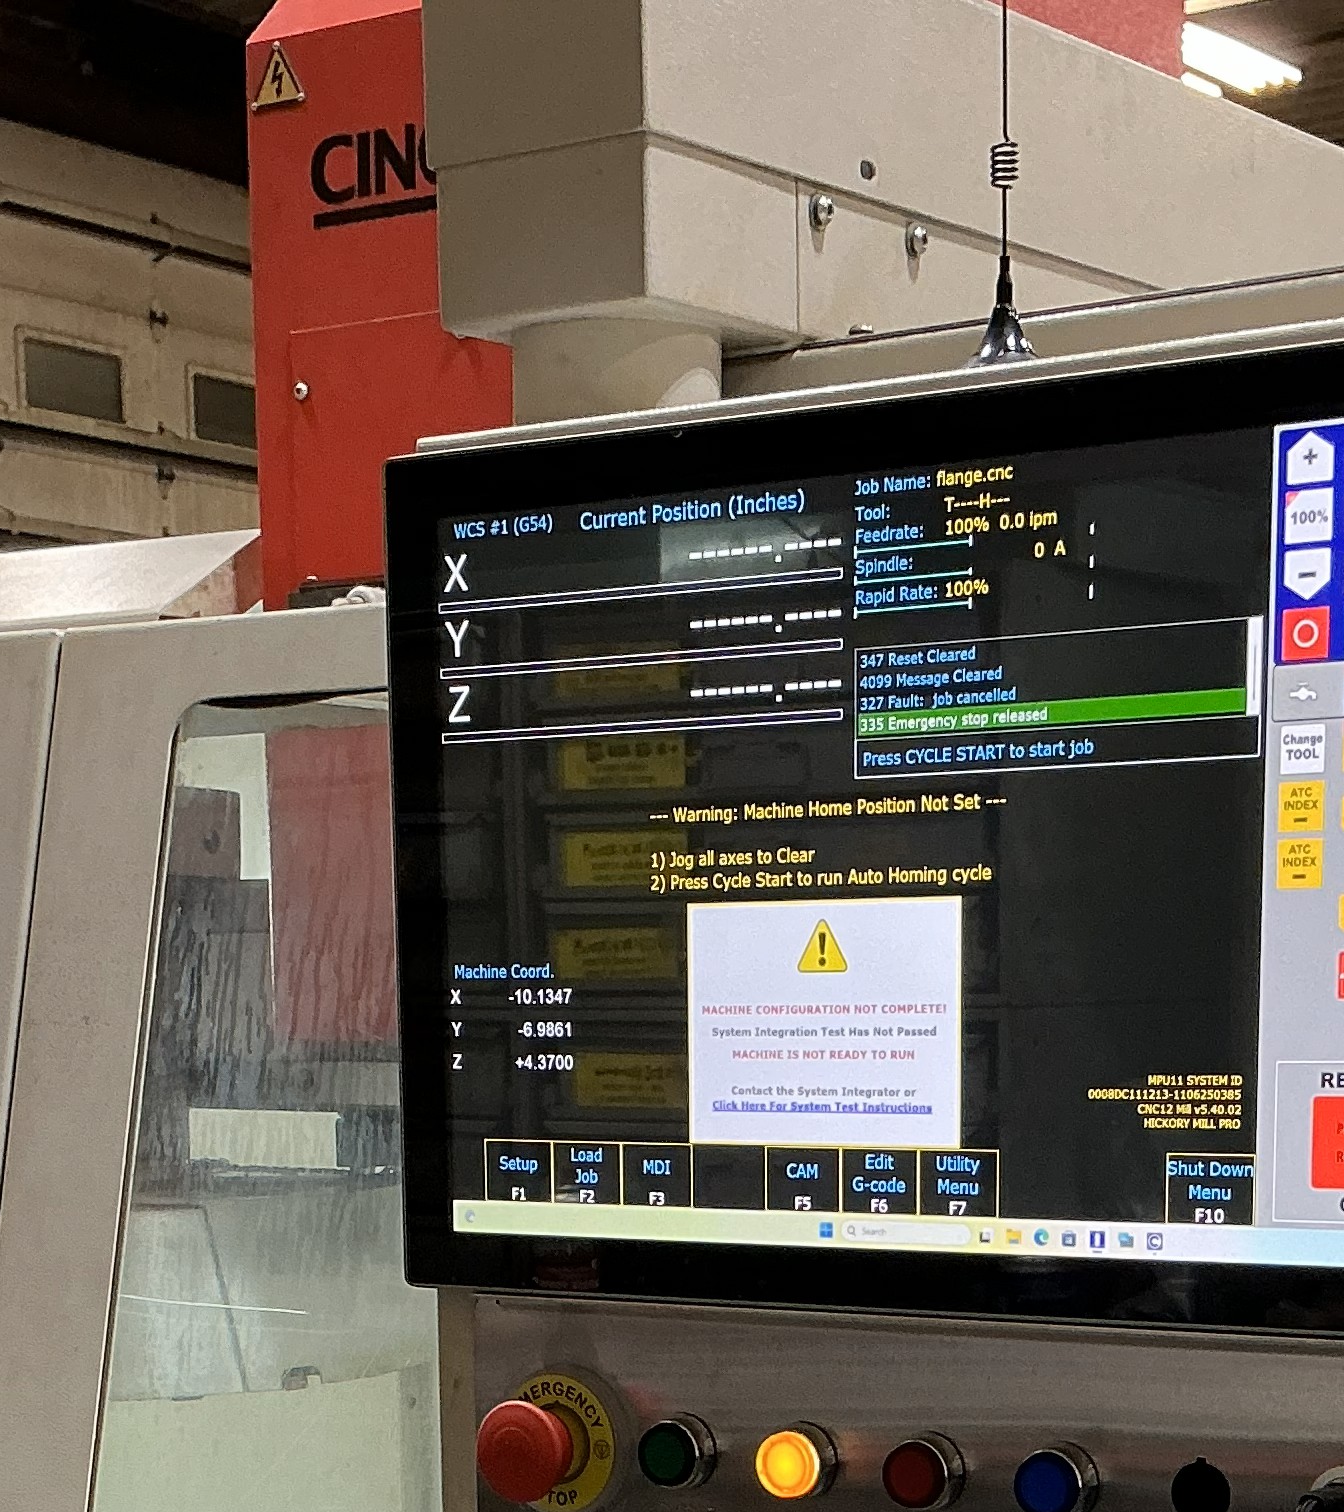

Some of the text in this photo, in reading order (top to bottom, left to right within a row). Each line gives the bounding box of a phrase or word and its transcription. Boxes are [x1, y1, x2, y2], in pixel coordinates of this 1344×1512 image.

[855, 466, 1013, 495] Job Name: flange.cnc
[580, 488, 804, 530] Current Position (Inches)
[1291, 510, 1328, 525] 100%
[454, 514, 552, 539] WCS #1 (G54)
[856, 510, 1057, 544] Feedrate: 100% 0.0 ipm
[444, 554, 468, 592] X
[856, 579, 989, 607] Rapid Rate: 100%
[445, 619, 469, 657] Y
[860, 645, 975, 668] 347 Reset Cleared
[449, 685, 470, 723] Z
[861, 707, 1047, 733] 335 Emergency stop released
[1283, 734, 1323, 746] Change
[864, 738, 1094, 766] Press CYCLE START to start job
[1286, 748, 1319, 760] TOOL
[673, 794, 981, 824] Warning: Machine Home Position Not Set
[651, 847, 815, 870] 1) Jog all axes to Clear
[651, 864, 992, 892] 2) Press Cycle Start to run Auto Homing cycle
[455, 963, 554, 979] Machine Coord.
[450, 988, 572, 1004] X -10.1347
[702, 1004, 946, 1014] MACHINE CONFIGURATION NOT COMPLETE!
[451, 1022, 571, 1037] Y -6.9861
[453, 1054, 573, 1070] Z +4.3700
[1148, 1075, 1242, 1086] MPU11 SYSTEM ID
[1144, 1118, 1241, 1129] HICKORY MILL PRO
[500, 1156, 538, 1174] Setup
[643, 1160, 670, 1175] MDI
[787, 1163, 818, 1179] CAM
[865, 1154, 894, 1170] Edit
[937, 1156, 980, 1175] Utility
[1168, 1161, 1254, 1178] Shut Down
[518, 1382, 603, 1428] MERGENCY
[547, 1490, 577, 1506] TOP
